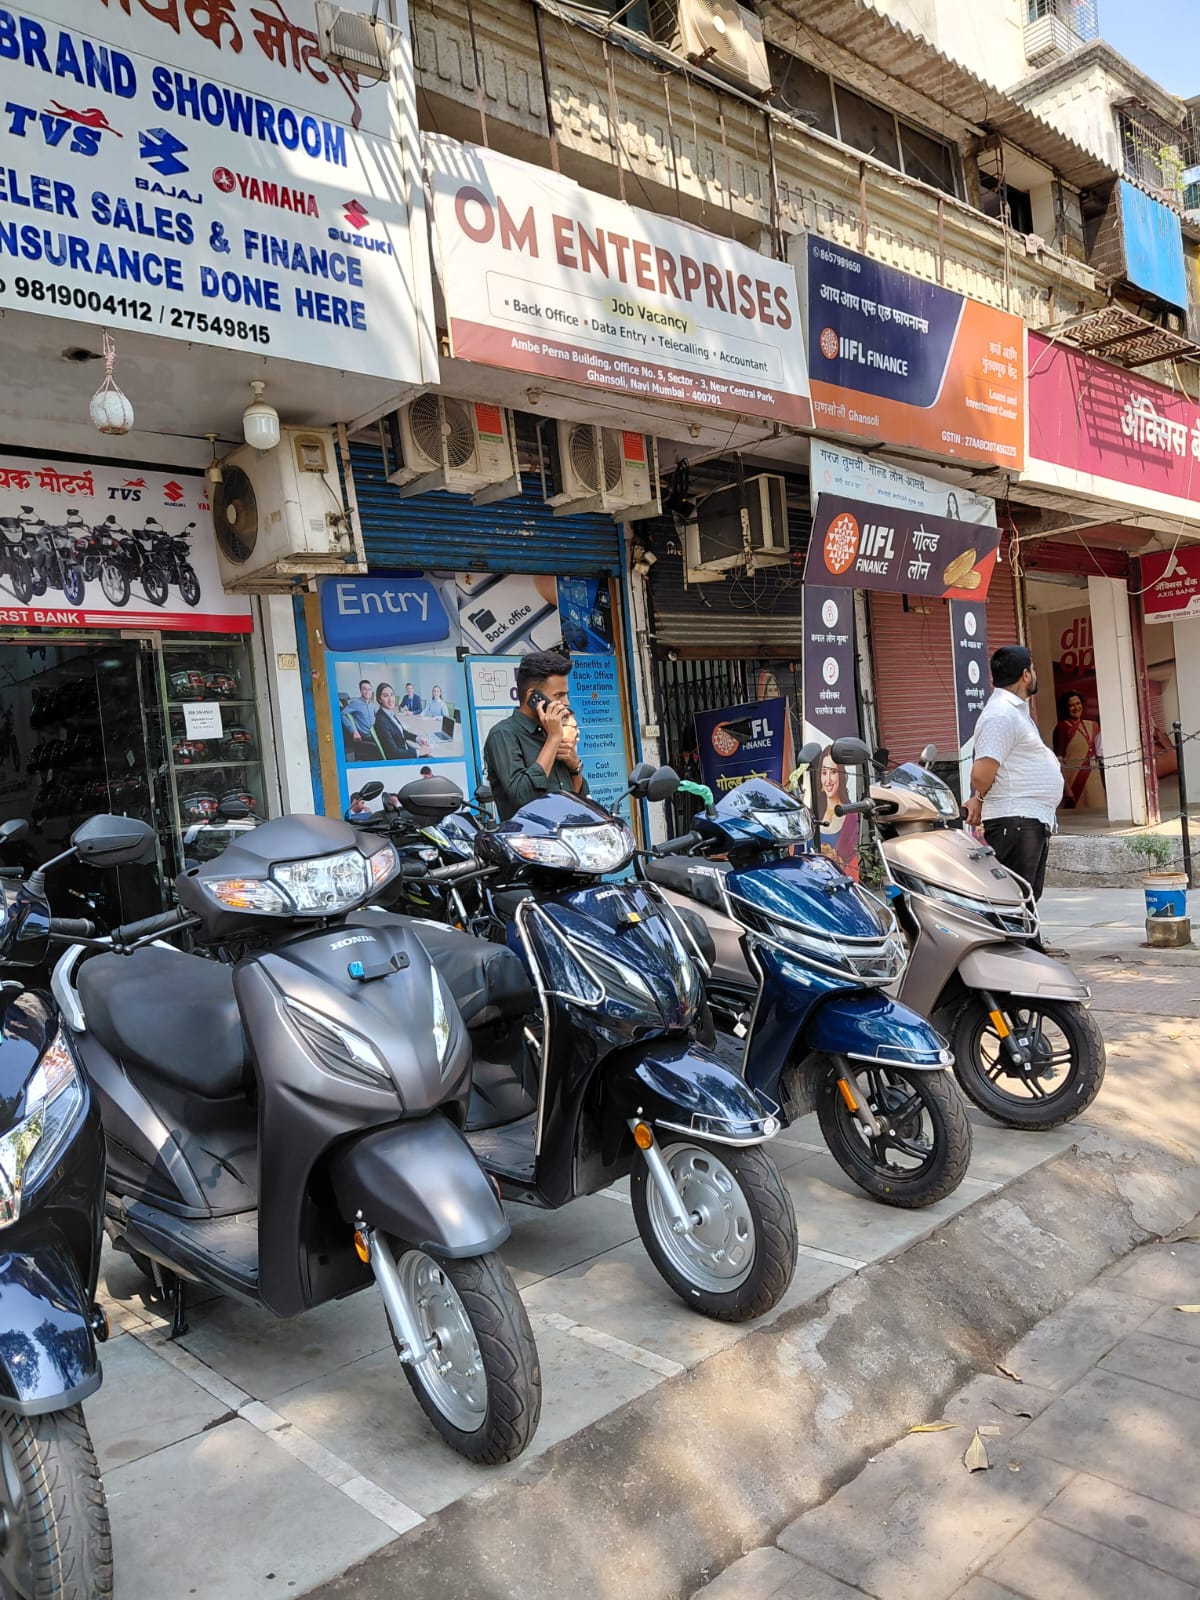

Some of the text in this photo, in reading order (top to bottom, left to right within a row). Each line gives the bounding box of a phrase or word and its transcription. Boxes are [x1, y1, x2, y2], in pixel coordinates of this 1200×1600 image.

[0, 9, 137, 99] BRAND
[152, 65, 348, 168] SHOWROOM
[5, 102, 102, 157] TVS
[135, 177, 203, 205] BAJAJ
[236, 176, 319, 218] YAMAHA
[91, 191, 195, 245] SALES
[210, 221, 231, 254] &
[243, 229, 364, 288] FINANCE
[327, 227, 392, 256] SUZUKI
[454, 185, 793, 331] OM ENTERPRISES
[15, 277, 152, 322] 9819004112
[170, 308, 271, 344] 27549815
[200, 266, 282, 313] DONE
[296, 287, 368, 331] HERE
[820, 284, 840, 304] आय
[840, 291, 860, 311] आय
[611, 299, 688, 333] Job Vacancy
[513, 299, 769, 373] Back Office Data Entry Telecalling Accountant
[511, 337, 541, 355] Ambe
[572, 350, 612, 372] Building,
[613, 359, 639, 375] Office
[641, 366, 656, 379] No.
[667, 372, 694, 386] Sector
[710, 381, 728, 394] Near
[729, 383, 756, 400] Central
[757, 389, 775, 404] Park,
[839, 337, 909, 376] IIFL FINANCE
[587, 369, 628, 390] Ghansoli,
[629, 378, 650, 392] Navi
[652, 382, 685, 399] Mumbai
[692, 390, 722, 405] 400701
[814, 400, 880, 427] घणसोली Ghansoli
[941, 430, 961, 444] GSTIN
[820, 448, 839, 465] गरज
[34, 466, 95, 496] मोटर्स
[108, 486, 142, 501] TVS
[858, 524, 895, 560] IIFL
[911, 523, 941, 553] गोल्ड
[855, 558, 889, 576] FINANCE
[907, 554, 931, 581] लोन
[335, 582, 428, 621] Entry
[1157, 587, 1197, 599] AXIS BANK
[34, 611, 80, 624] BANK
[485, 603, 532, 644] Back office
[574, 660, 605, 669] Benefits
[594, 671, 614, 680] Office
[576, 682, 613, 692] Operations
[585, 732, 614, 740] Increased
[748, 718, 774, 739] FL
[584, 741, 617, 750] Productivity
[588, 771, 619, 780] Reduction
[595, 762, 610, 770] Cost
[330, 935, 377, 952] HONDA
